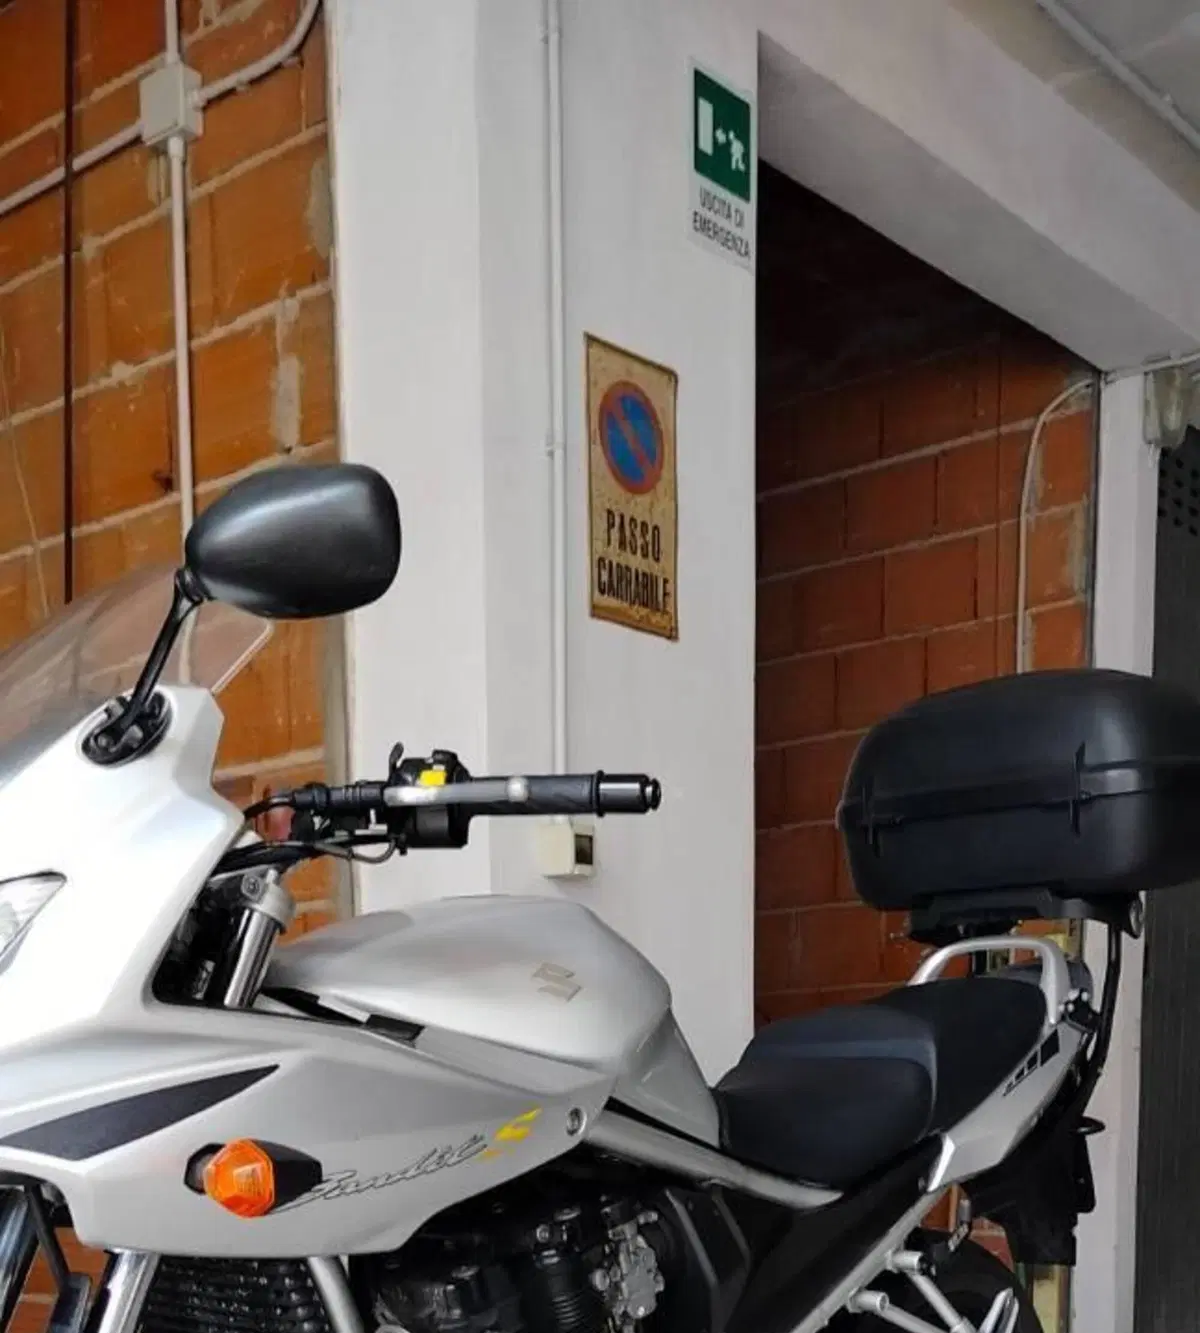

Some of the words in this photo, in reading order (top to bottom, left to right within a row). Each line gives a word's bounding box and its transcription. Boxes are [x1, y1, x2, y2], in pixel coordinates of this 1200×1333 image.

[700, 186, 732, 221] USCITA
[734, 207, 745, 229] DI
[692, 209, 752, 260] EMERGENZA
[606, 508, 661, 563] PASSO
[597, 556, 671, 616] CARRABILE
